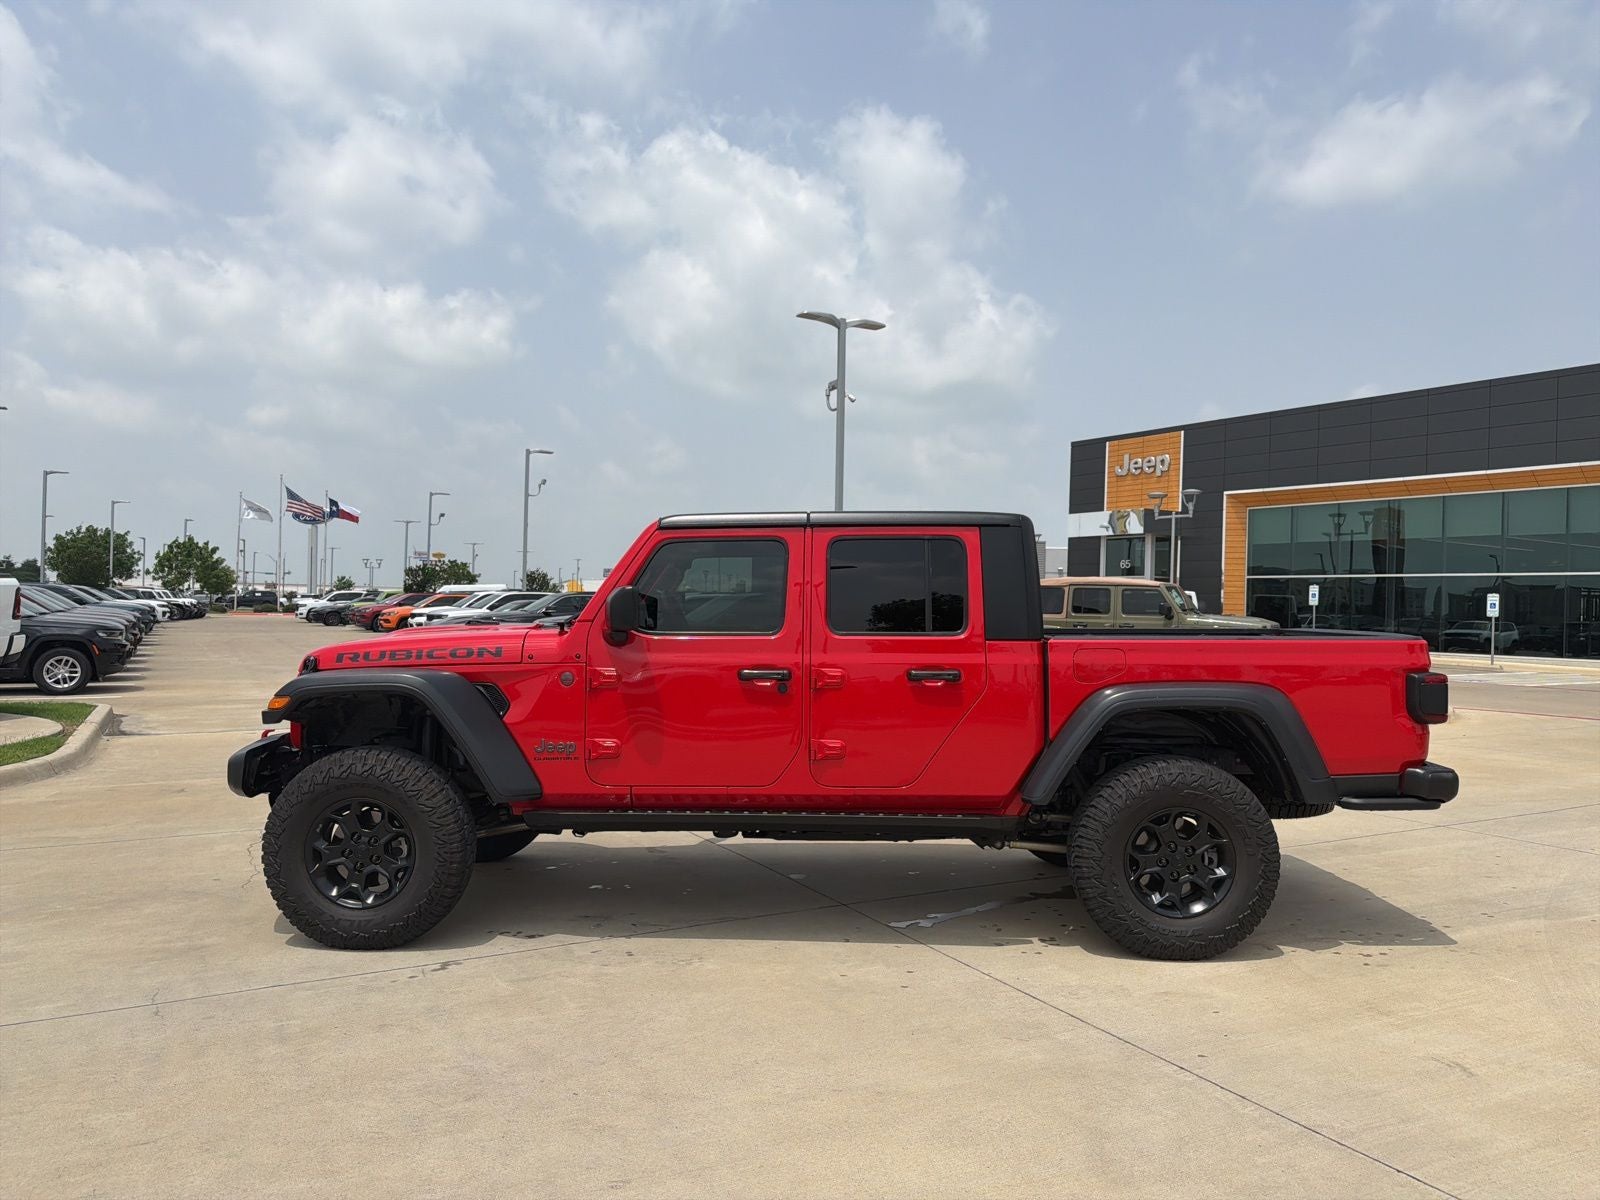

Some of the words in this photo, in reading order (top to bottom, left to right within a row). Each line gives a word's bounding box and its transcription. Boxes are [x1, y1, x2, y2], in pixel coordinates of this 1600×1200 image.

[1114, 452, 1170, 477] Jeep
[1119, 559, 1131, 569] 65
[335, 646, 503, 664] RUBICON
[534, 738, 577, 756] Jeep
